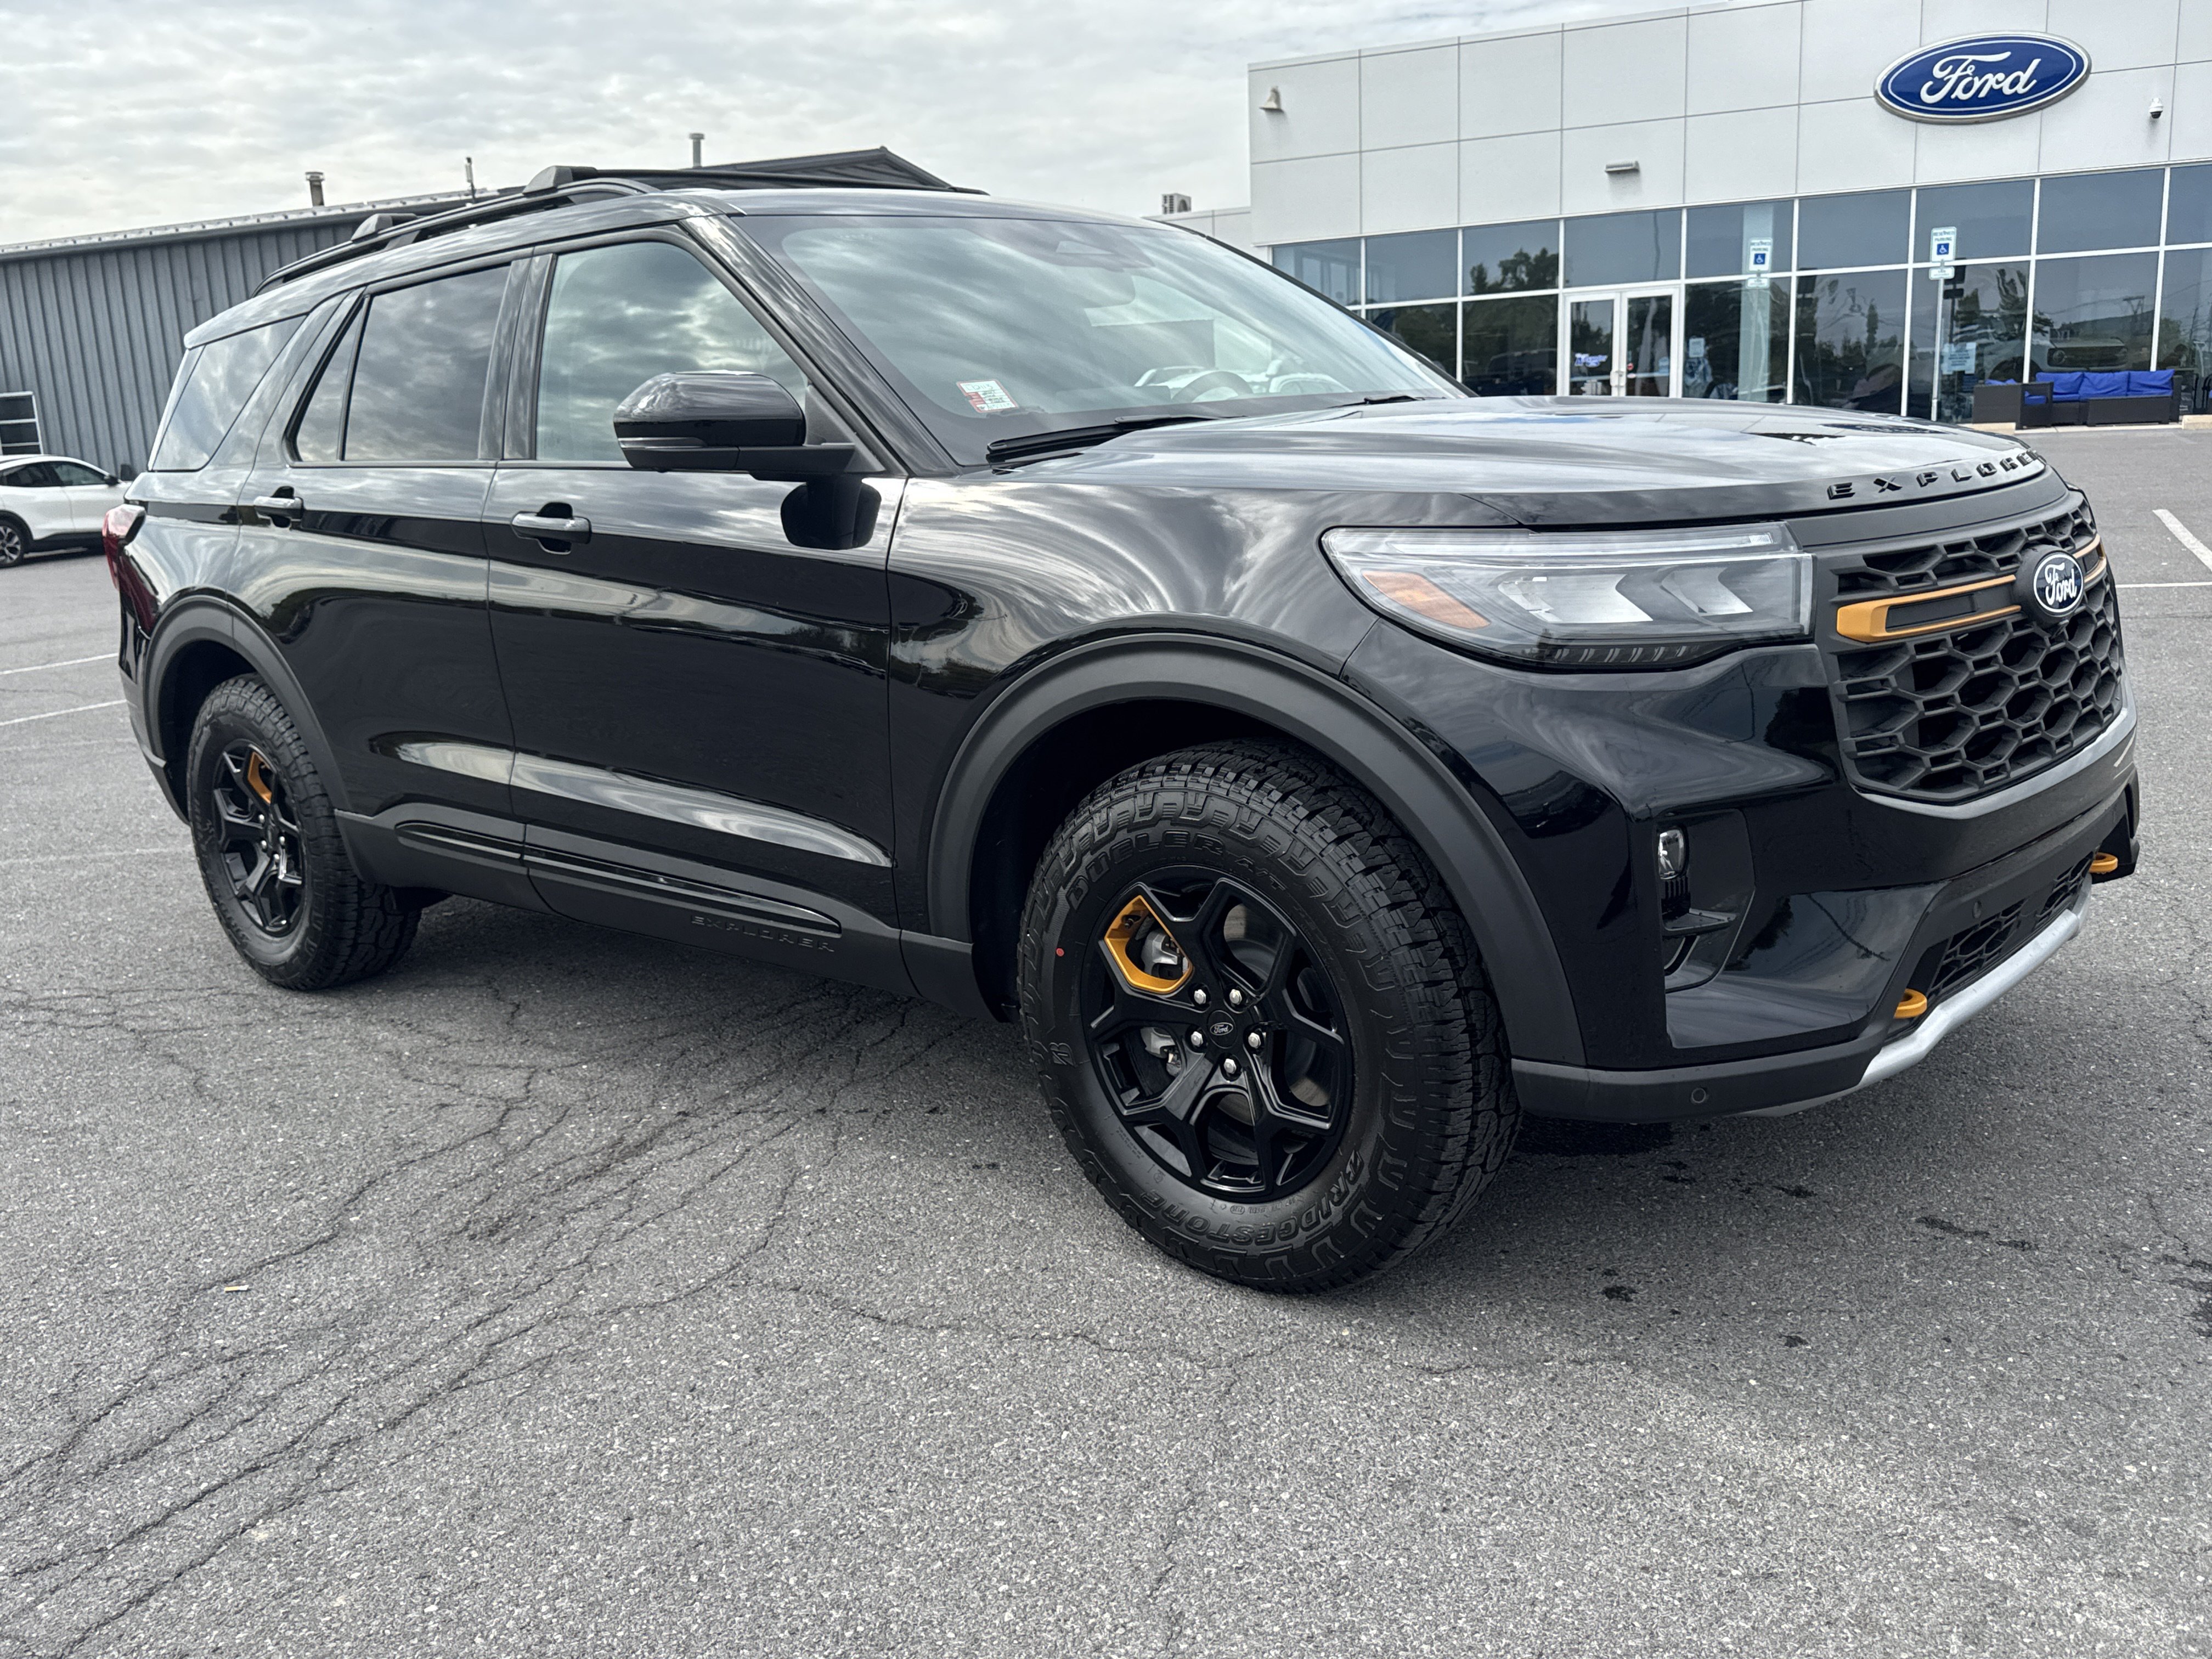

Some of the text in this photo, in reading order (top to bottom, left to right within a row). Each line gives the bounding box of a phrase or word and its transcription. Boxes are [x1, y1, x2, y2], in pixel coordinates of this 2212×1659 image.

[1920, 51, 2042, 104] Ford
[2045, 563, 2078, 605] Ford
[1066, 830, 1226, 910] DUELER
[691, 915, 834, 952] EXPLORER
[1214, 1024, 1229, 1034] Ford
[1140, 1149, 1365, 1246] BRIDGESTONE
